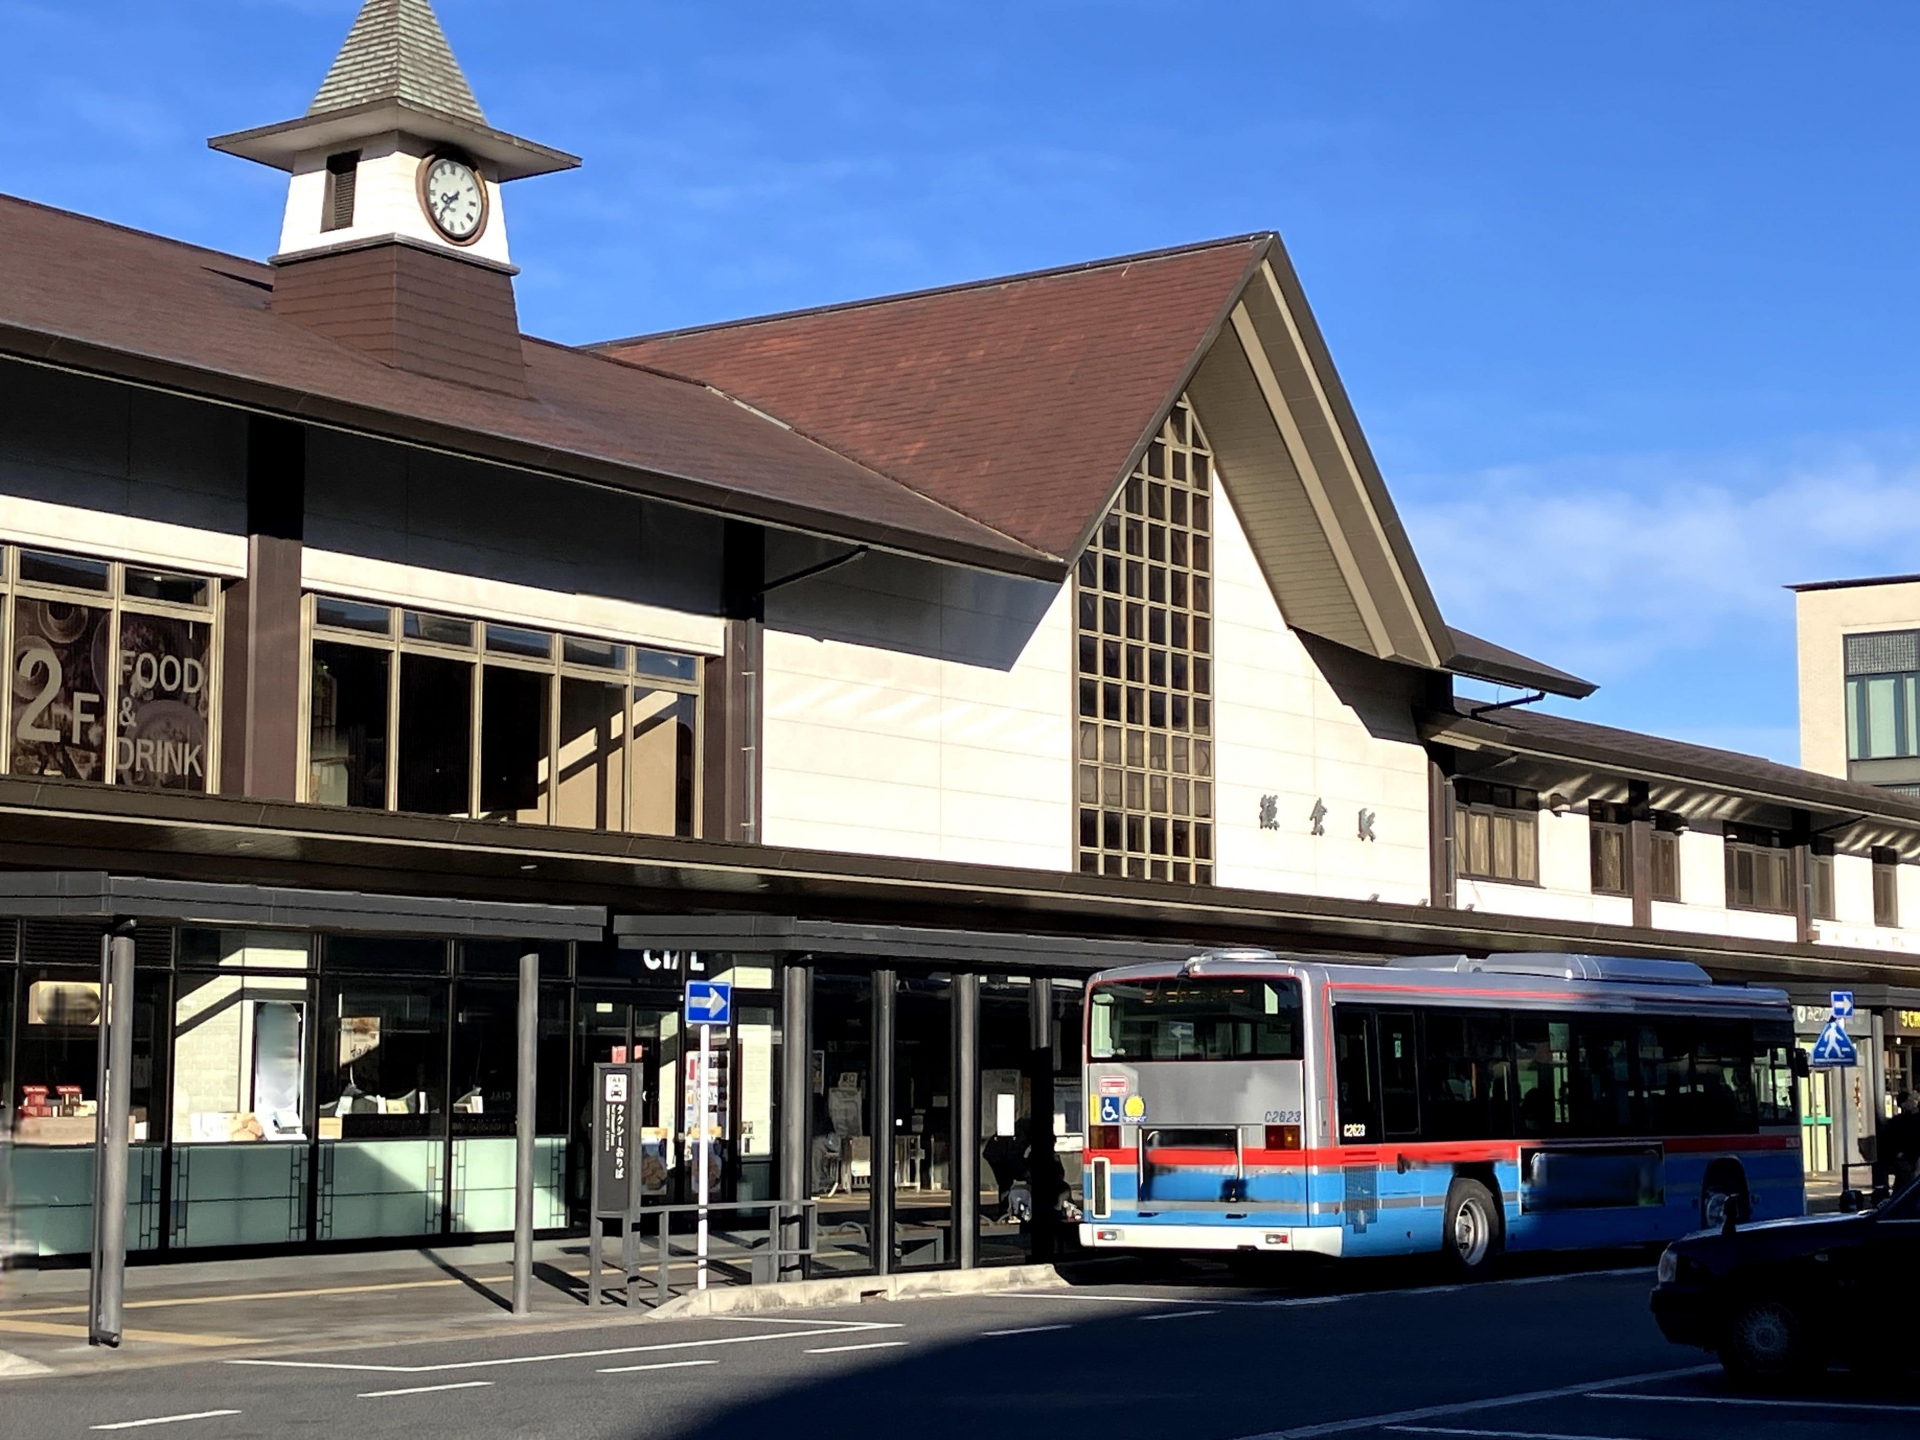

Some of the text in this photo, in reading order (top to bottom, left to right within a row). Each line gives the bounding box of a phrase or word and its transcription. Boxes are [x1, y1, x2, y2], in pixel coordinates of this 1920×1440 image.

[119, 649, 205, 693] FOOD
[16, 646, 100, 745] 2F
[119, 697, 137, 727] &
[116, 736, 204, 778] DRINK
[1264, 1110, 1302, 1123] C2623
[614, 1104, 625, 1180] タクシーおりば
